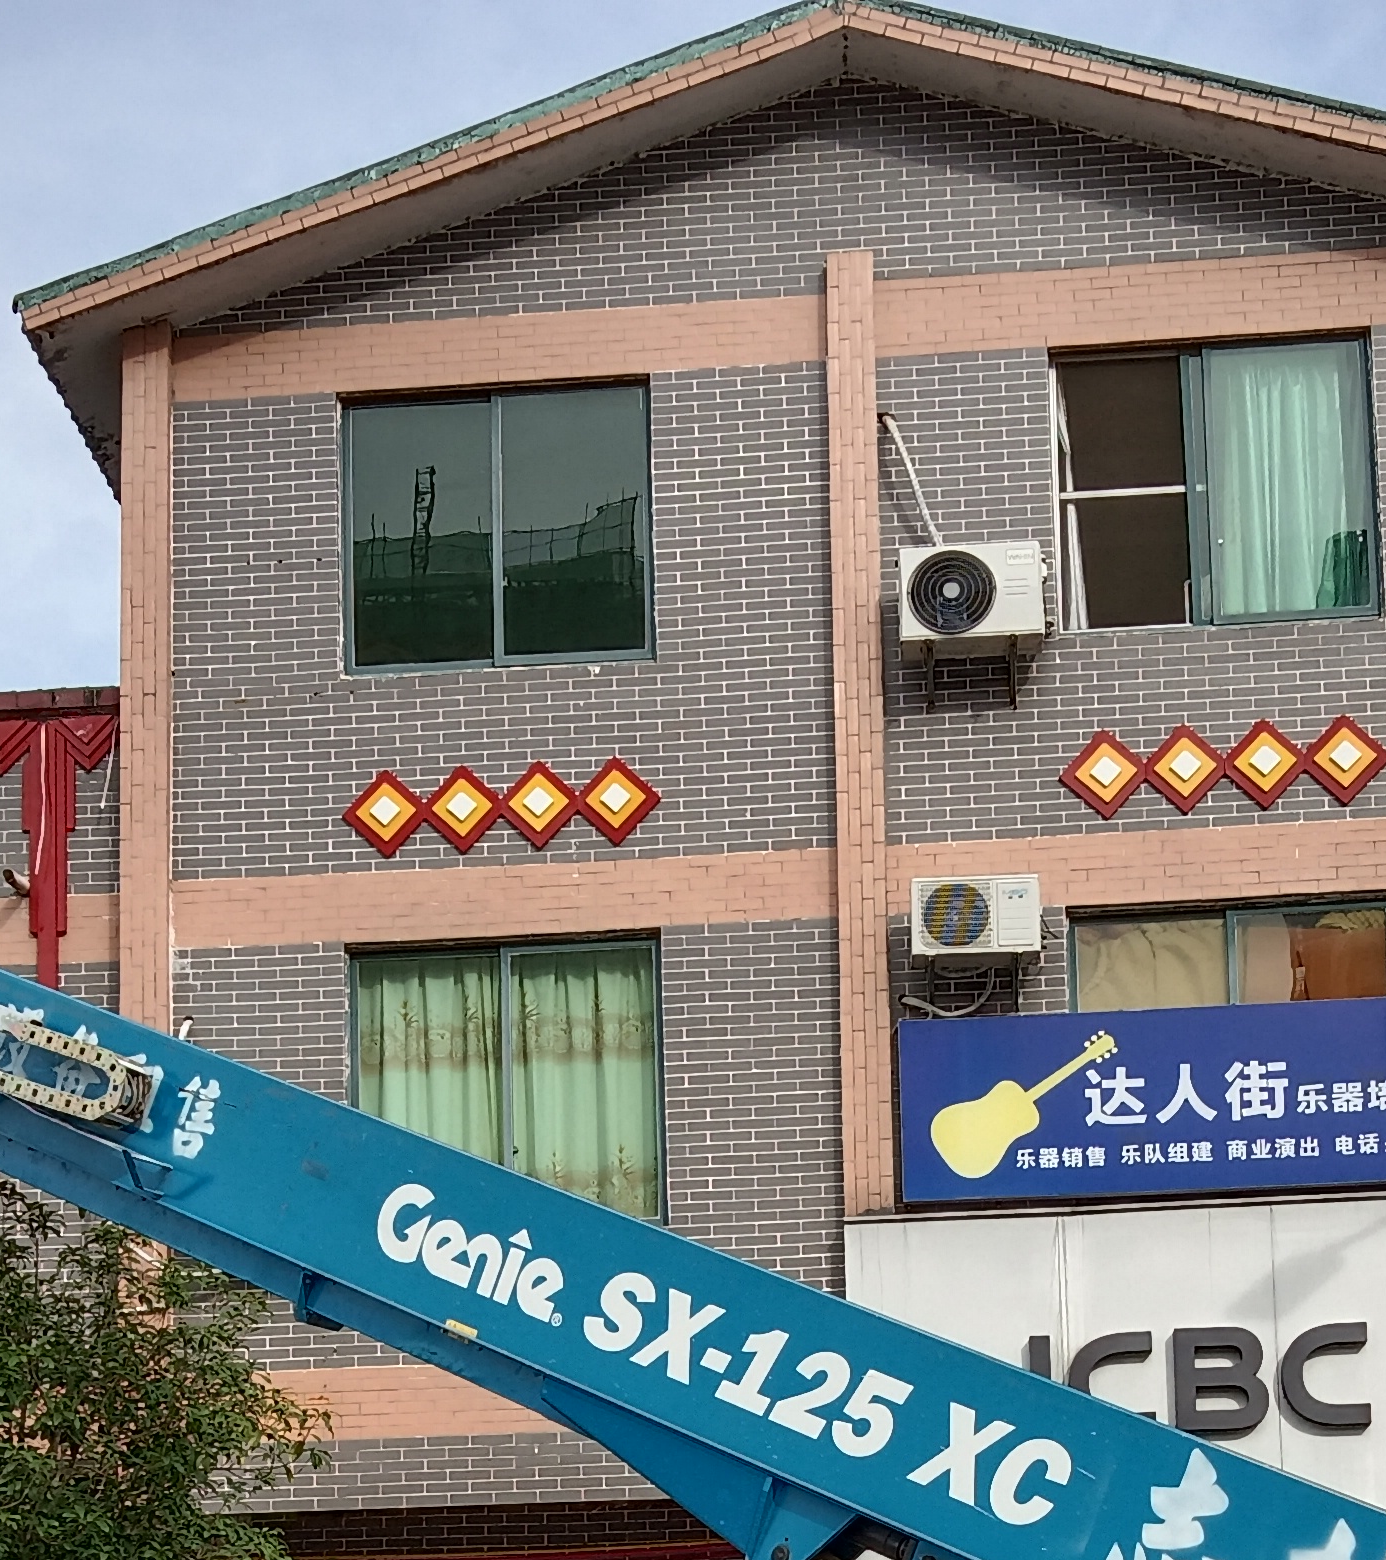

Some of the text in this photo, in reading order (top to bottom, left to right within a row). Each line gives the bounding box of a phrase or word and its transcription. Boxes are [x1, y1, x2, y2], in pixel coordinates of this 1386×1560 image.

[1083, 1060, 1290, 1128] 达人街
[1015, 1145, 1107, 1170] 乐器销售
[1119, 1139, 1214, 1166] 乐队组建
[1227, 1135, 1321, 1162] 商业演出
[583, 1271, 914, 1458] SX-125
[905, 1401, 1073, 1526] XC
